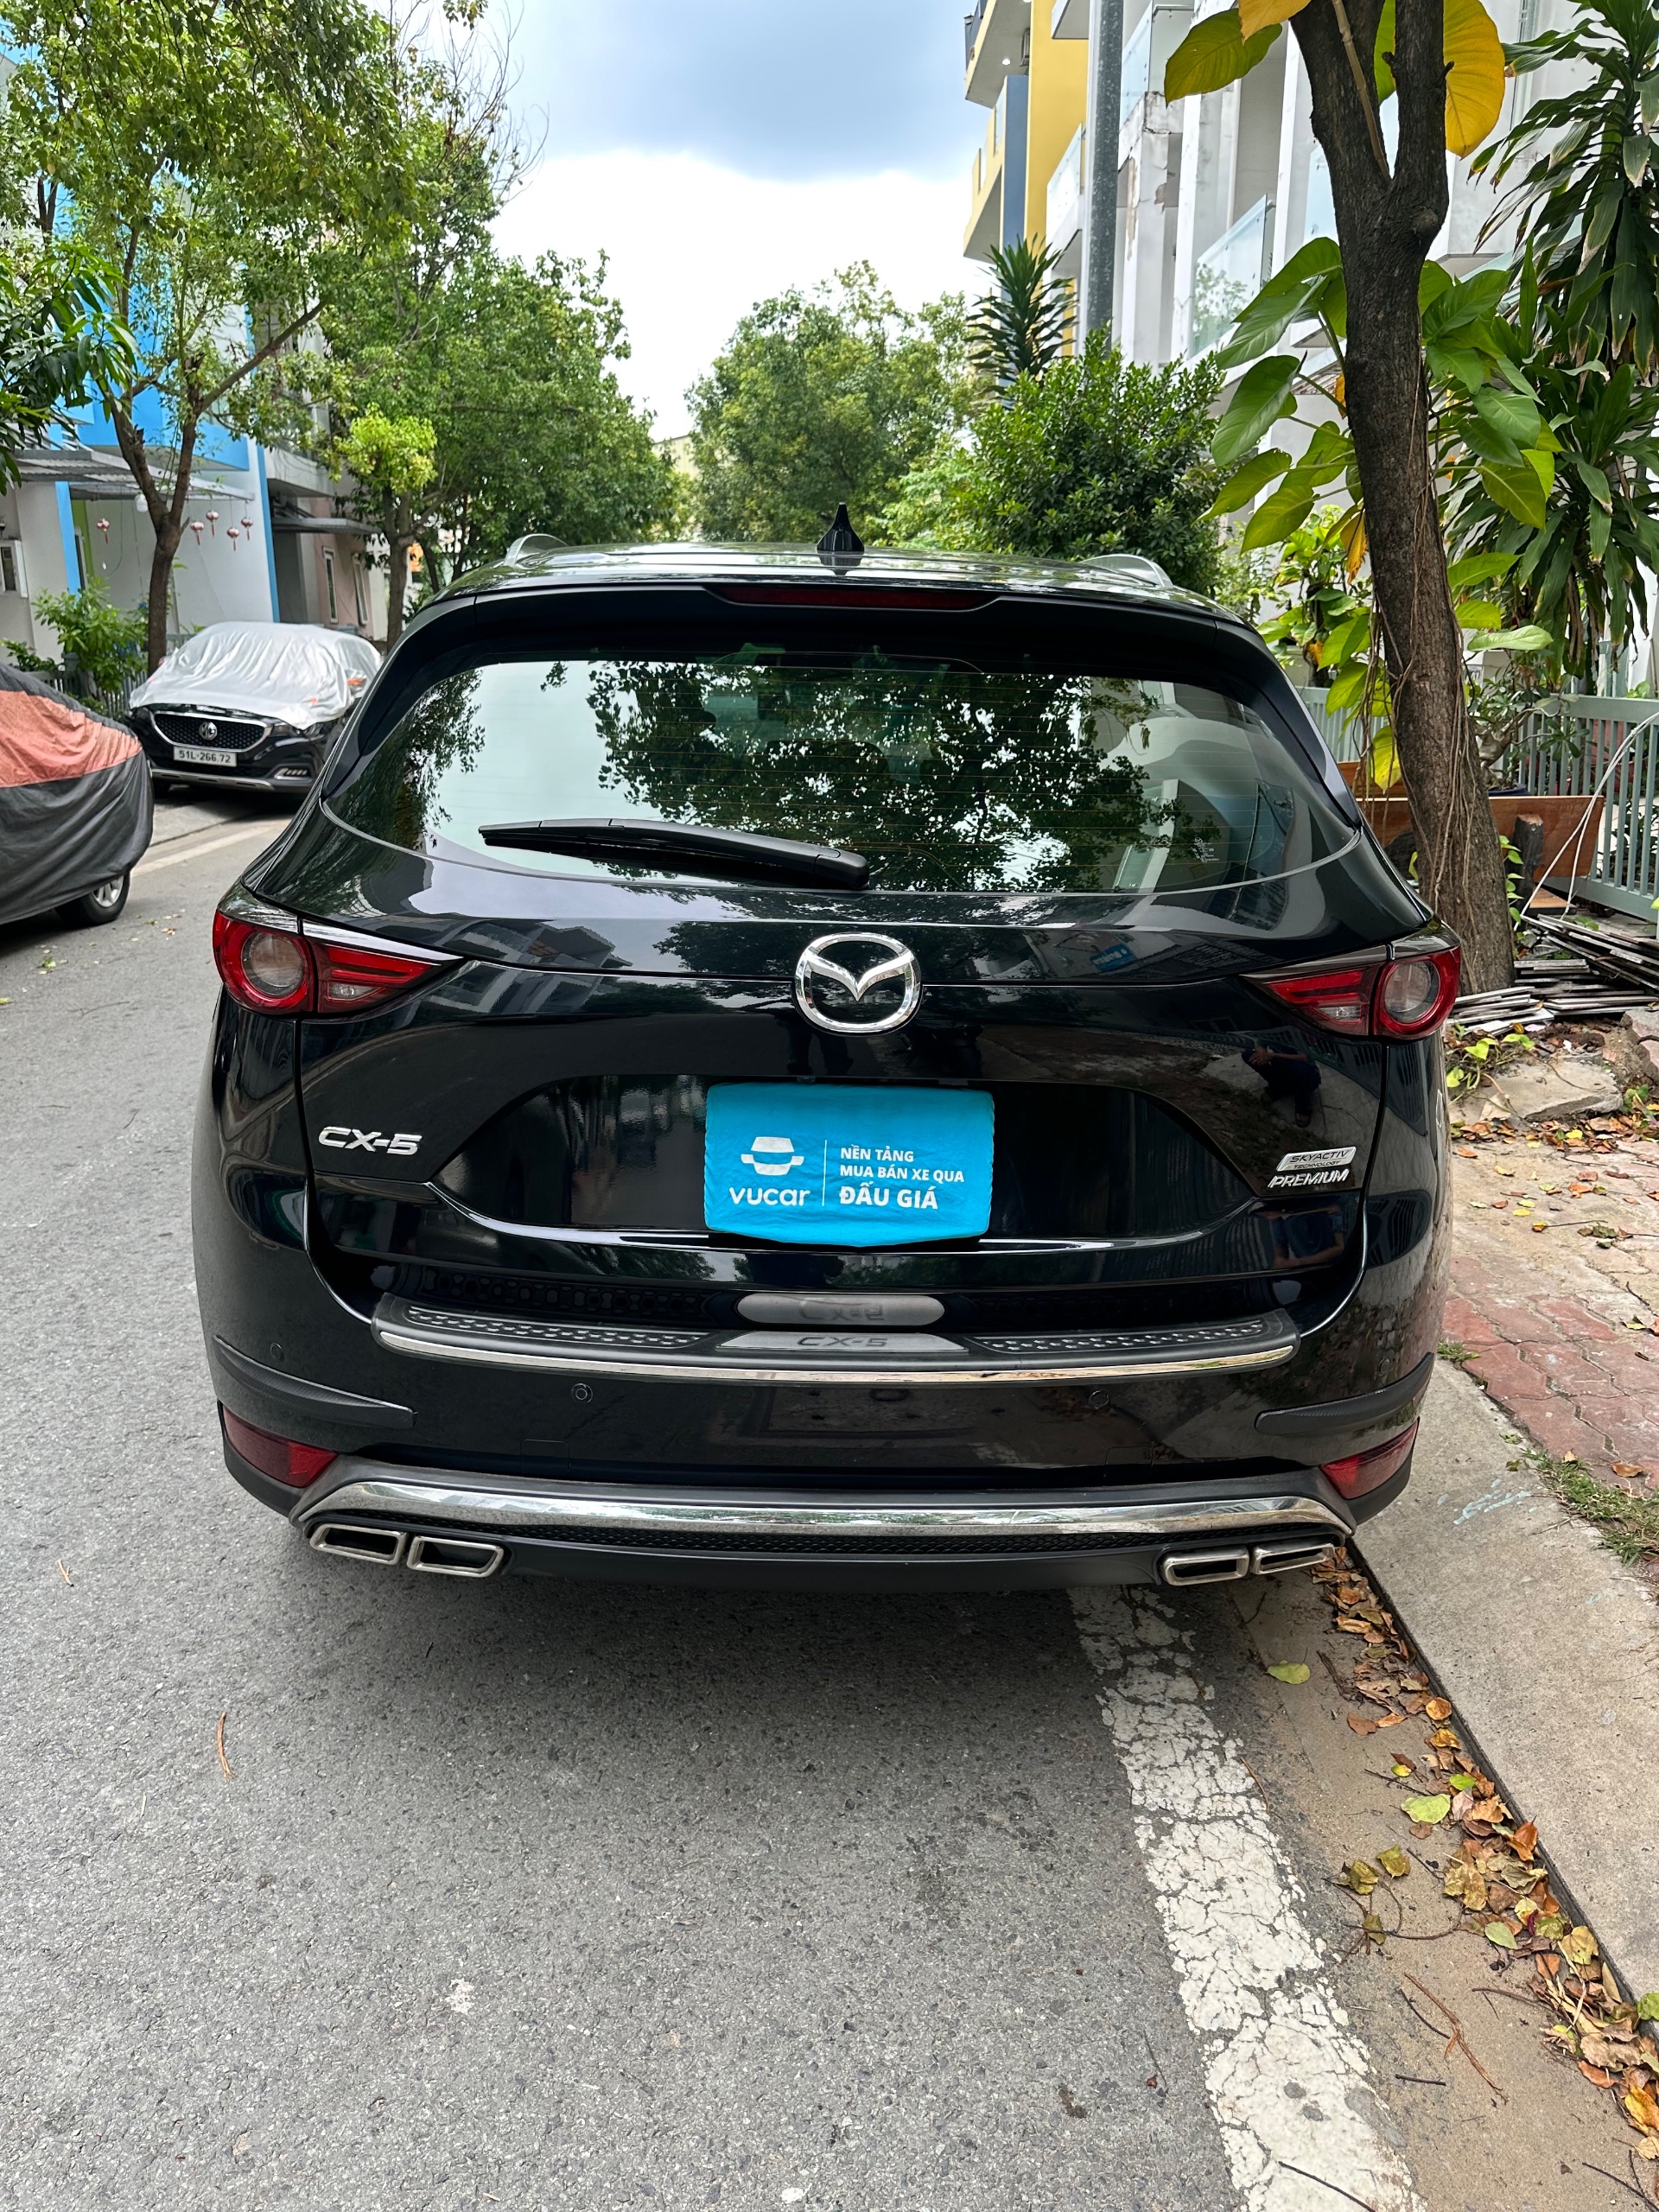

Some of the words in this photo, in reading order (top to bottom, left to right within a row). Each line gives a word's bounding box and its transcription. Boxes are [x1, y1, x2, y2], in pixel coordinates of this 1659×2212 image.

[318, 1126, 423, 1155] CX-5
[840, 1143, 871, 1160] NỀN
[874, 1145, 914, 1163] TẢNG
[1289, 1150, 1350, 1163] SKYACTIV
[840, 1164, 874, 1179] MUA
[877, 1164, 908, 1179] BÁN
[911, 1168, 930, 1181] XE
[932, 1169, 965, 1185] QUA
[1294, 1160, 1341, 1169] TECHNOLOGY
[1267, 1168, 1350, 1189] PREMIUM
[728, 1186, 811, 1206] vucar
[839, 1180, 890, 1206] ĐẤU
[896, 1185, 938, 1210] GIÁ
[797, 1337, 888, 1348] CX-5
